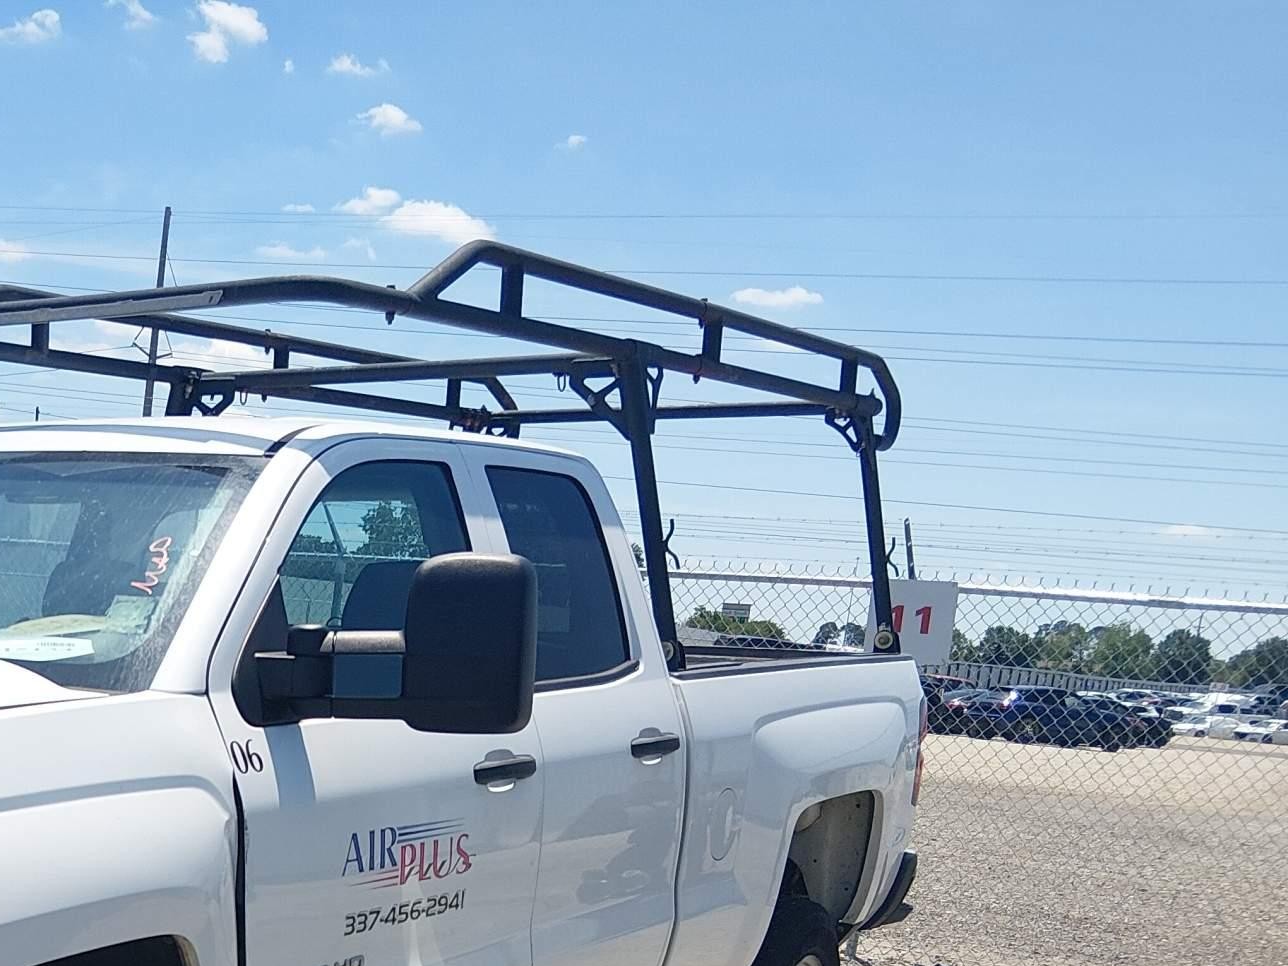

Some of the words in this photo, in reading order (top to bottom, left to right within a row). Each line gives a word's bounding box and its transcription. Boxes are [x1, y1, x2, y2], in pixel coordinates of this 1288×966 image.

[891, 604, 932, 635] 11
[230, 739, 263, 774] 06
[342, 827, 398, 877] AIR
[399, 833, 472, 886] PLUS
[344, 888, 466, 937] 337-456-2941
